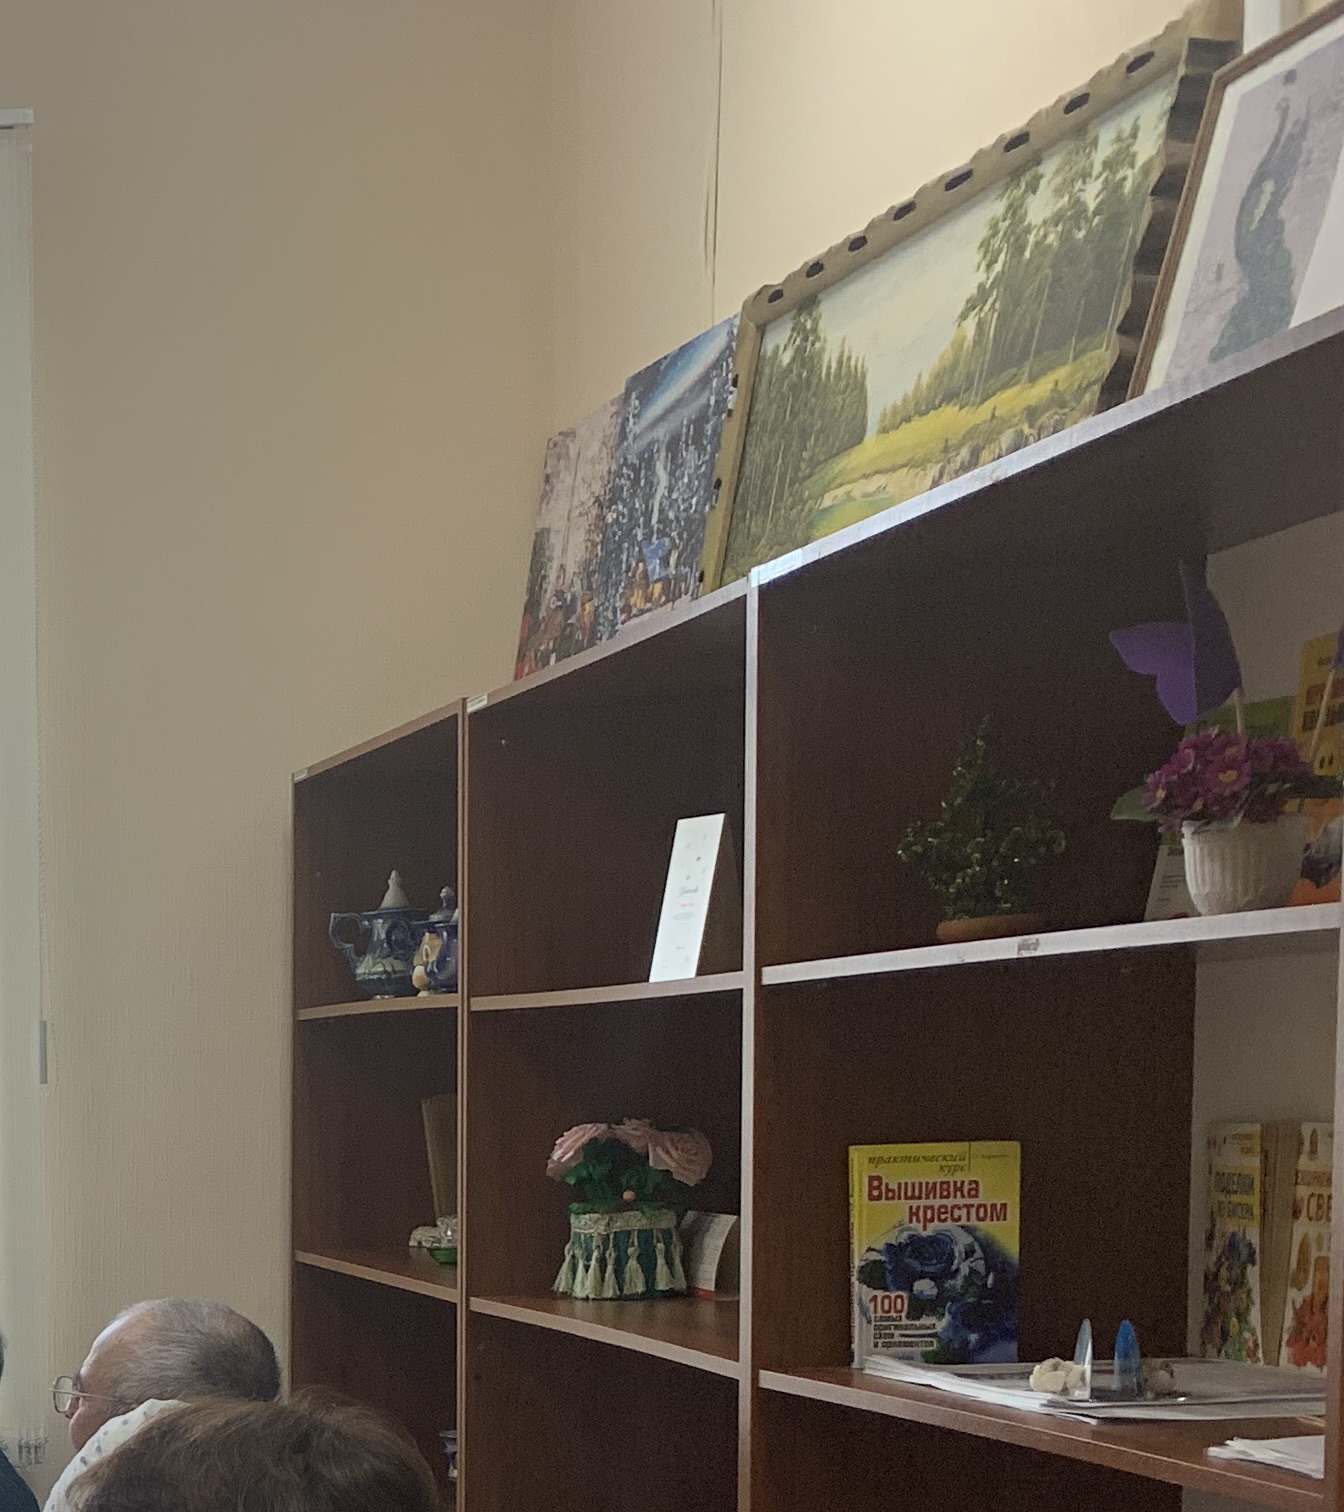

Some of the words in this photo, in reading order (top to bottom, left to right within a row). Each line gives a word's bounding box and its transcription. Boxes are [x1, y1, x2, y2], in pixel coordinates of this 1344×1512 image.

[867, 1175, 980, 1201] Вышивка
[908, 1202, 1008, 1231] крестом
[869, 1294, 905, 1314] 100
